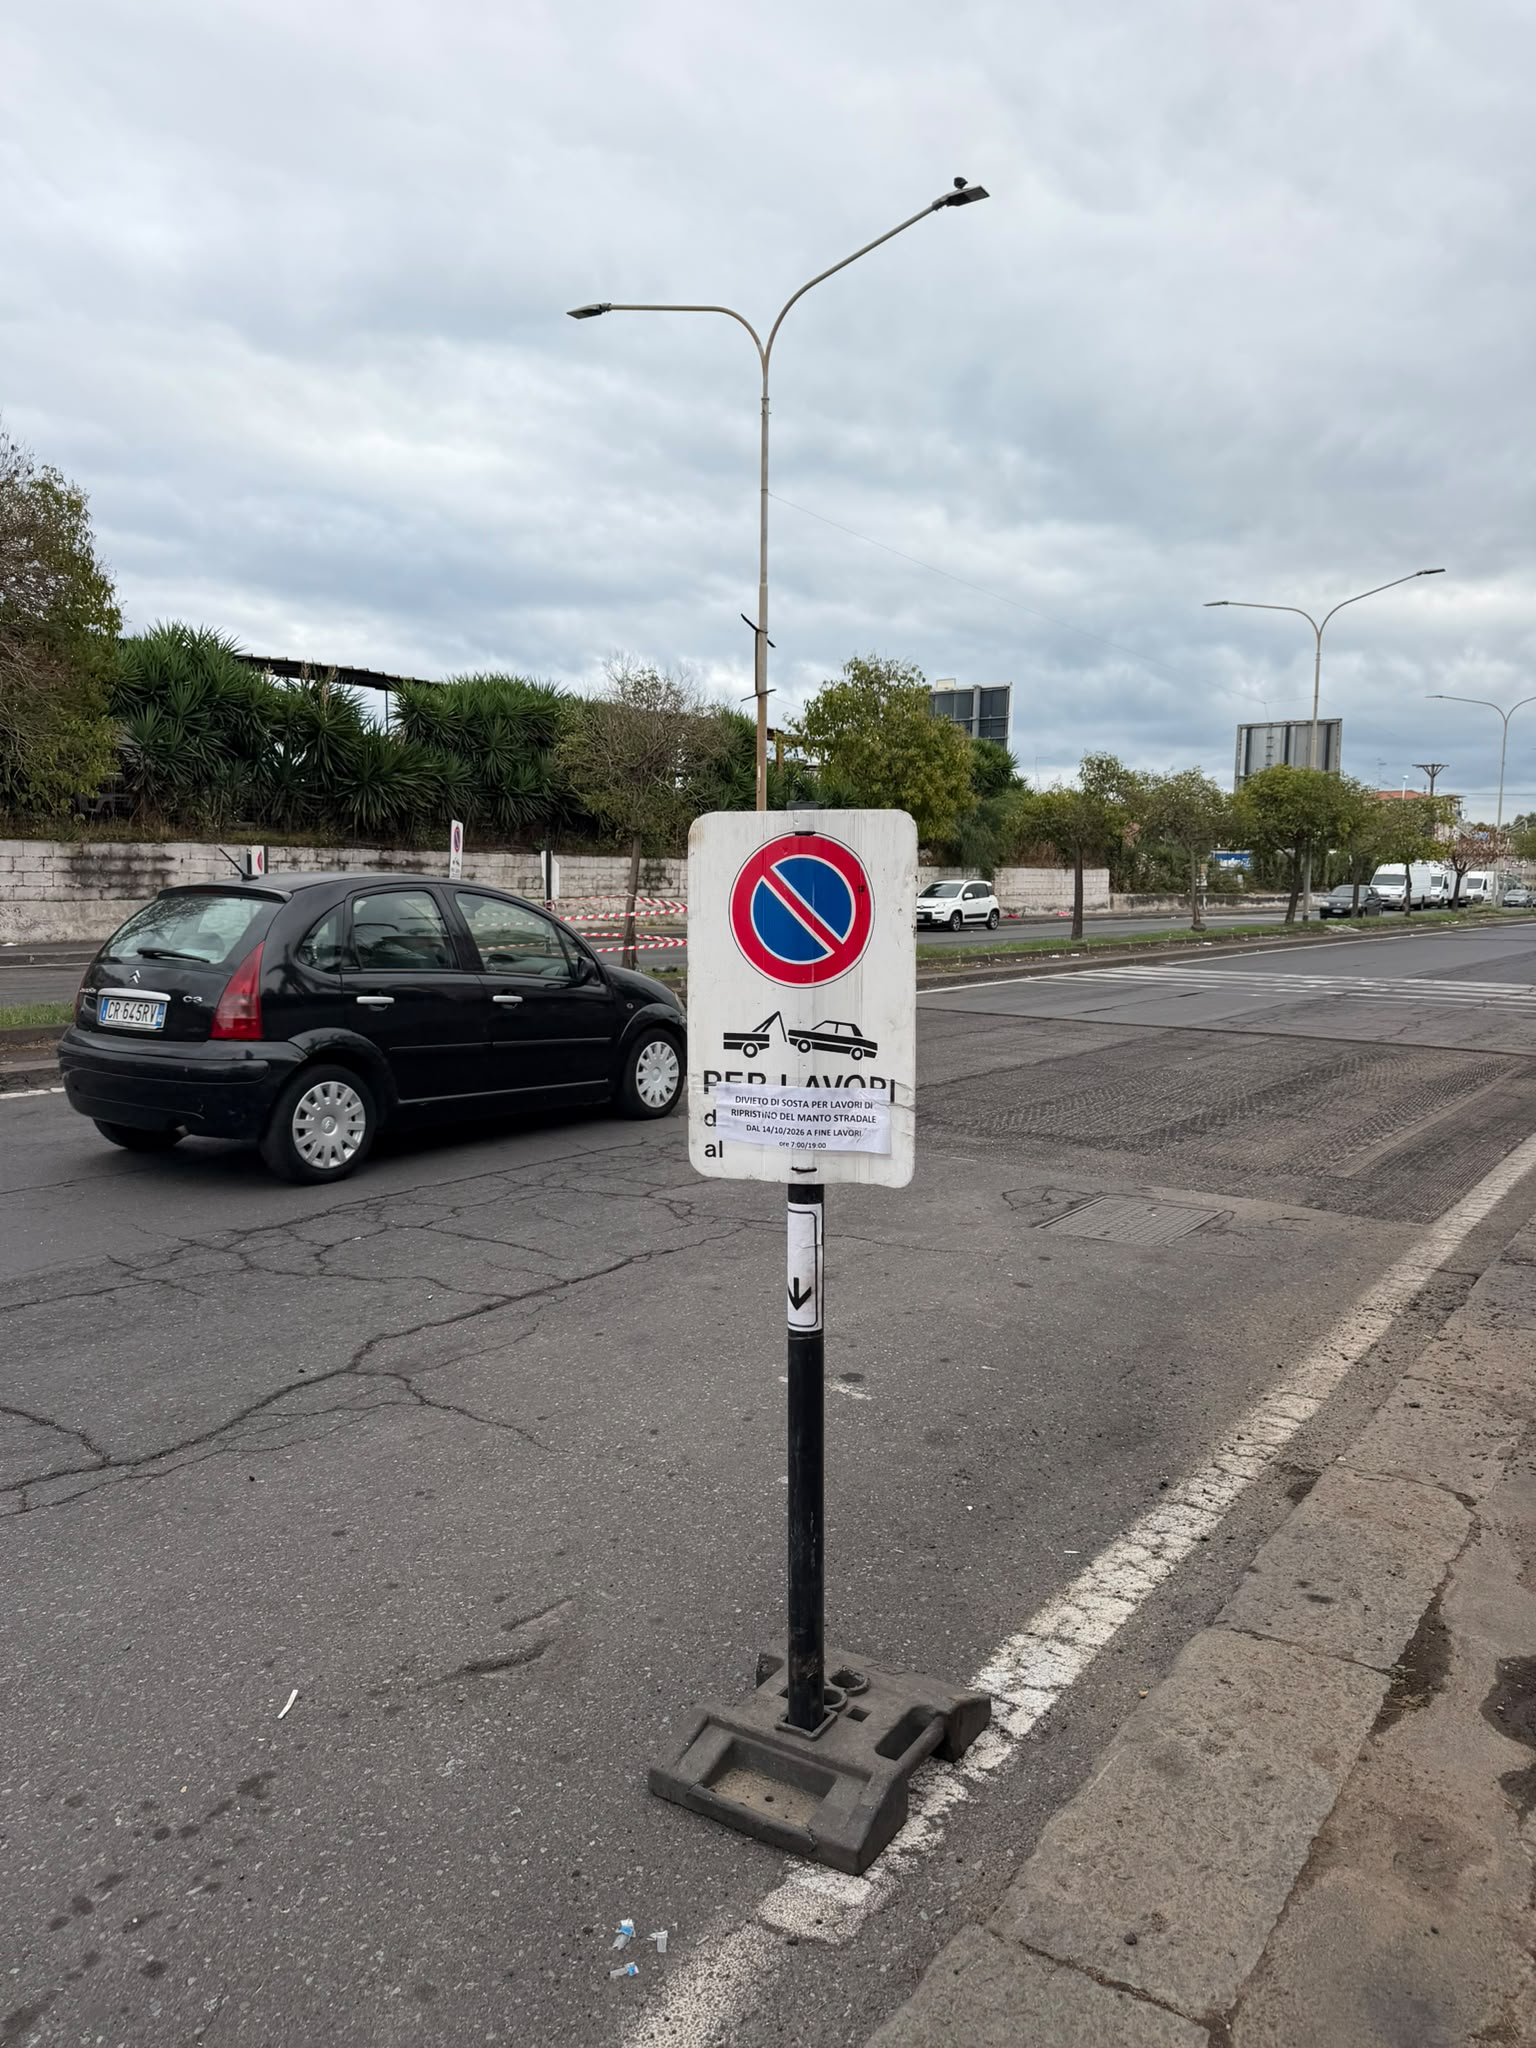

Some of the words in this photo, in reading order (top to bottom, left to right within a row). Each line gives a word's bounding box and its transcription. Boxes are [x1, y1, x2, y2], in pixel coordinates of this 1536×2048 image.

[183, 995, 203, 1004] C3
[107, 1001, 120, 1019] CR
[122, 1002, 158, 1022] 645RV
[735, 1095, 769, 1106] DIVIETO
[770, 1098, 780, 1106] DI
[781, 1099, 810, 1108] SOSTA
[811, 1100, 829, 1109] PER
[830, 1101, 863, 1109] LAVORI
[864, 1102, 873, 1110] DI
[731, 1108, 778, 1120] RIPRISTINO
[779, 1112, 796, 1121] DEL
[797, 1113, 832, 1122] MANTO
[833, 1114, 877, 1124] STRADALE
[746, 1124, 761, 1133] DAL
[762, 1125, 805, 1136] 14/10/2026
[806, 1128, 813, 1137] A
[814, 1129, 832, 1137] FINE
[833, 1129, 862, 1137] LAVORI
[704, 1140, 723, 1158] al
